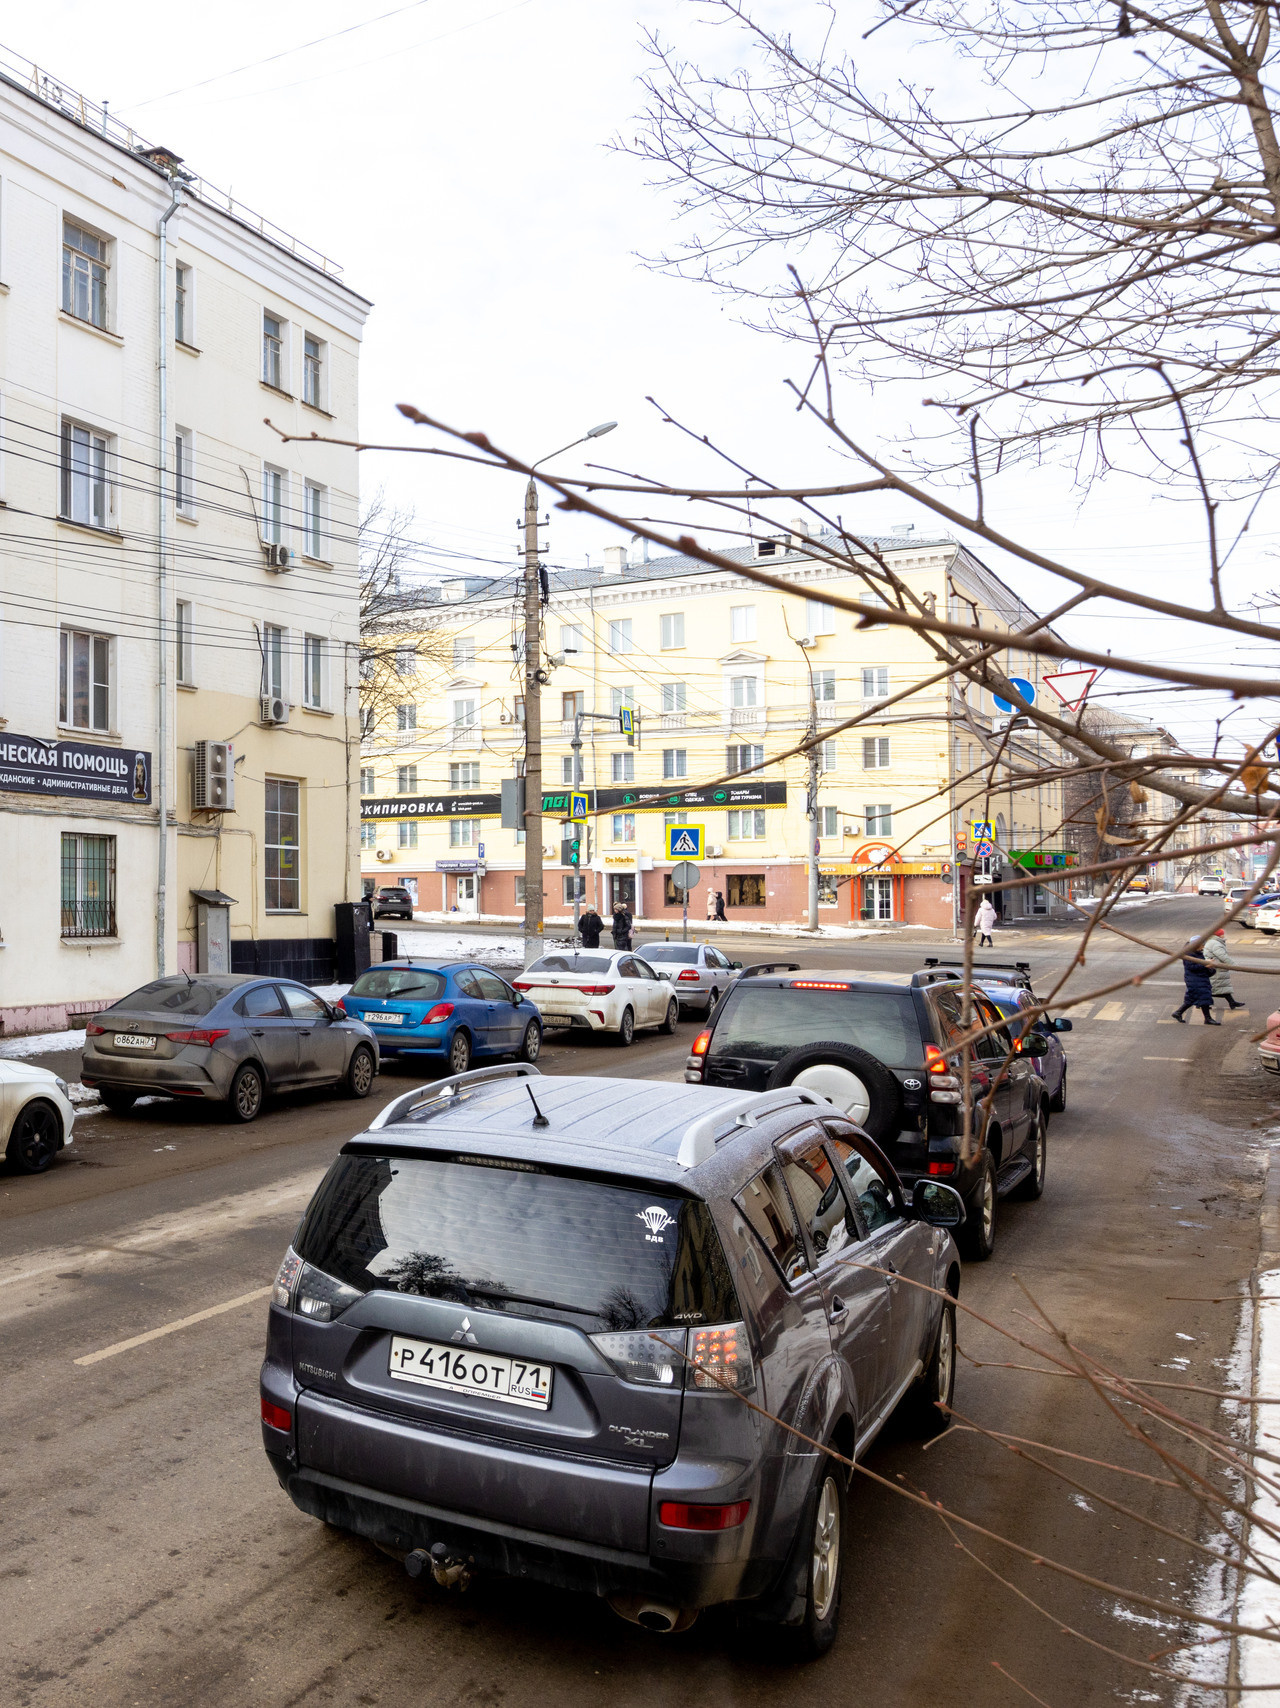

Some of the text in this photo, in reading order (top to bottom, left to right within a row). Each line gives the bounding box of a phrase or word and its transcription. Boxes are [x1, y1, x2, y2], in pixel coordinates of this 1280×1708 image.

[63, 752, 128, 777] ПОМОЩЬ
[42, 778, 111, 793] АДМИНИСТРАТИВНЫЕ
[111, 786, 128, 794] ДЕЛА
[645, 1234, 664, 1243] ВДВ
[400, 1347, 541, 1388] Р416ОТ 71
[511, 1385, 531, 1395] RUS
[609, 1425, 669, 1439] OUTLANDER
[624, 1436, 654, 1448] XL
